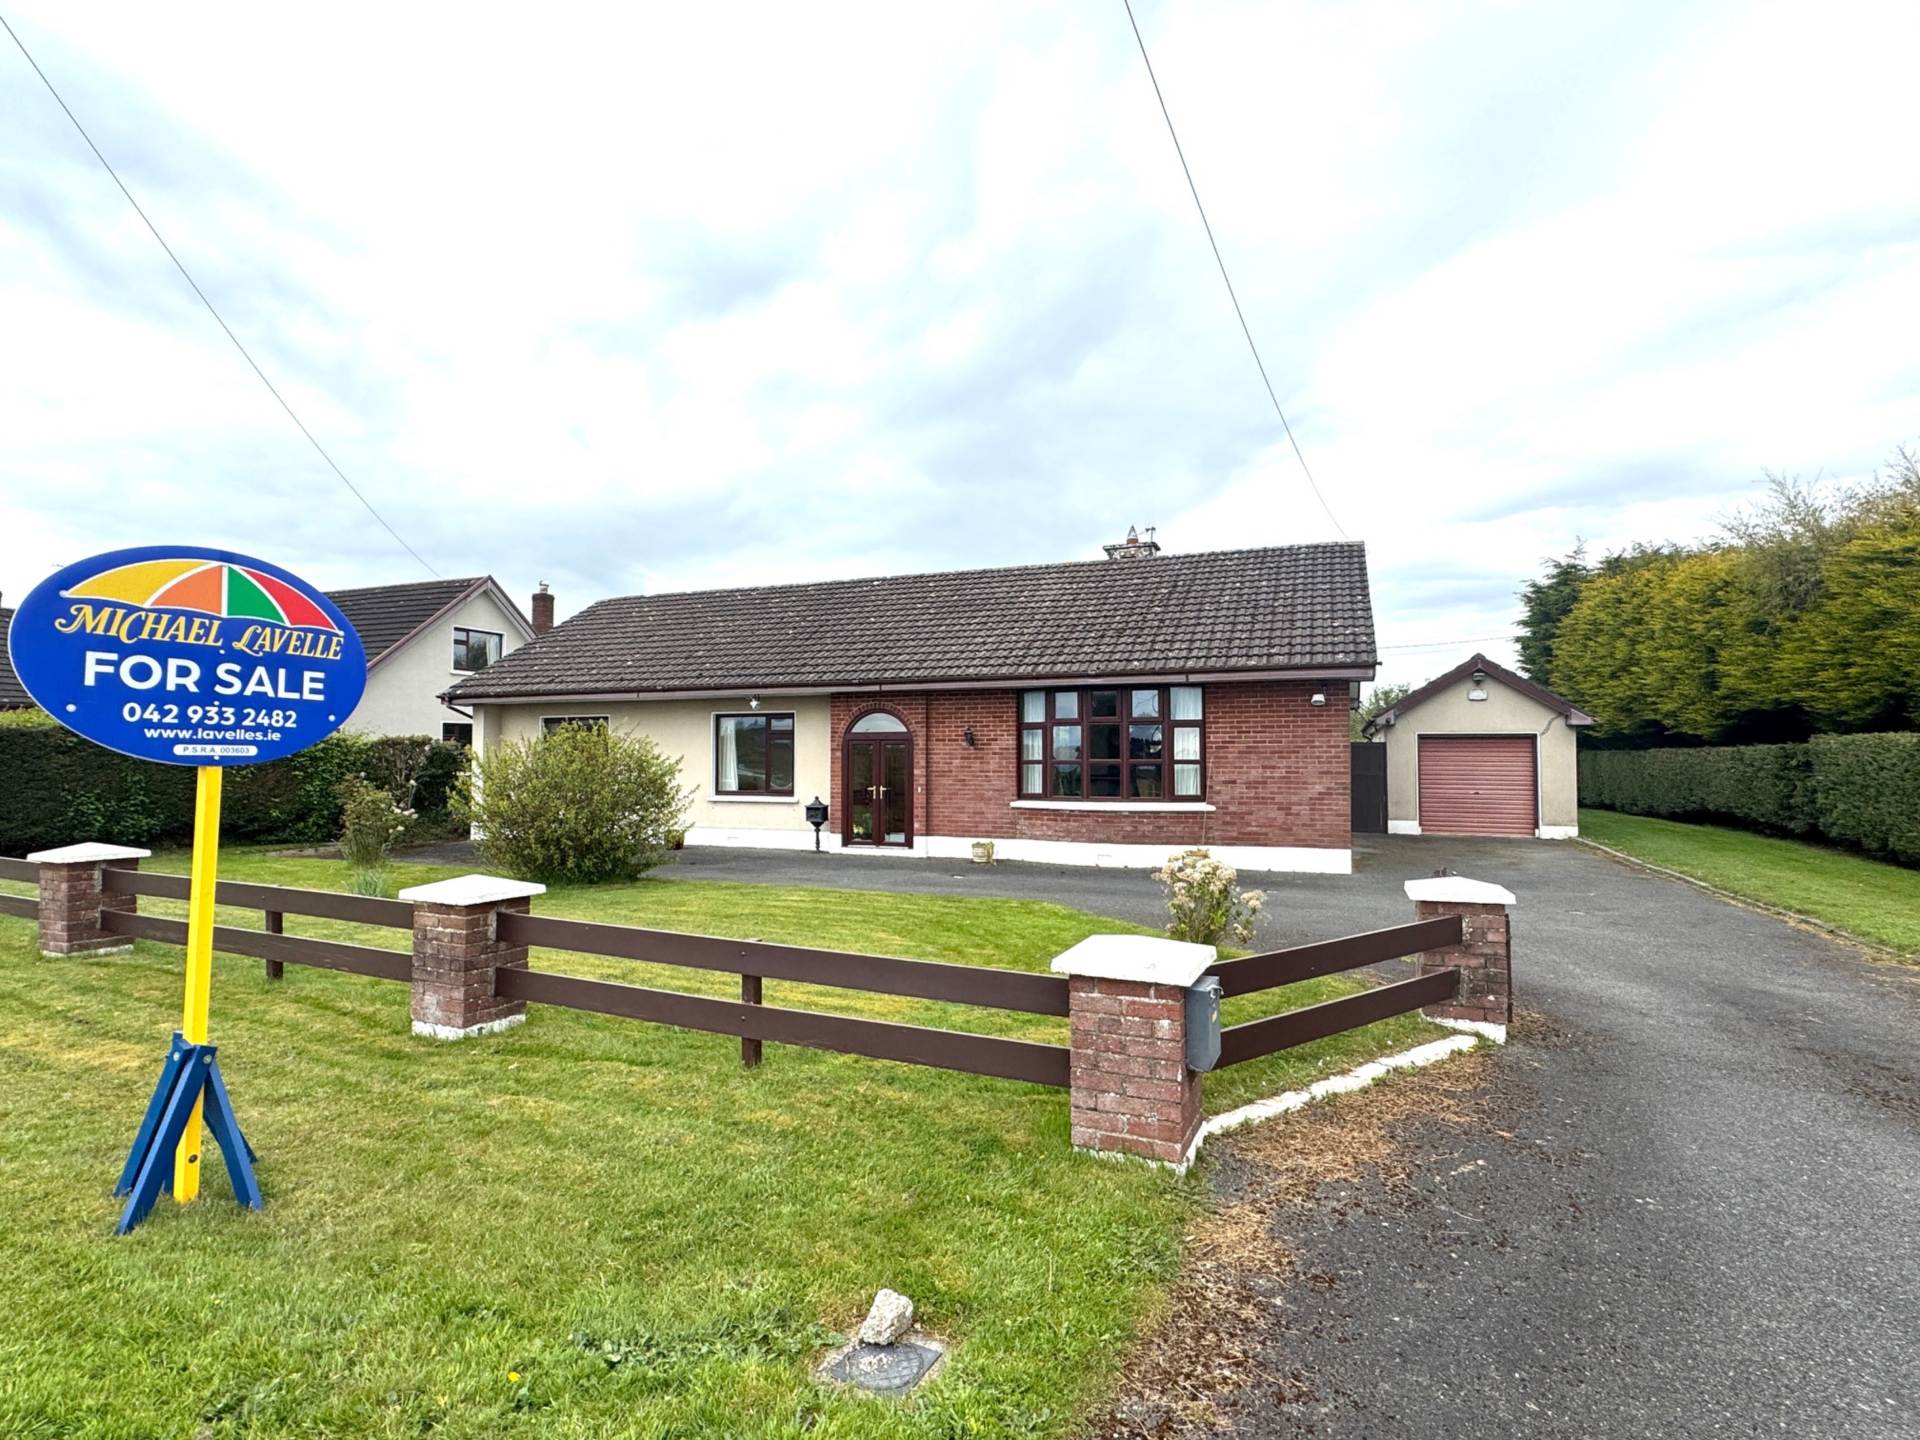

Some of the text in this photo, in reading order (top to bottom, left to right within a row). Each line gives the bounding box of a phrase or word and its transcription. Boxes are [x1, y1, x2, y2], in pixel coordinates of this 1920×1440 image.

[55, 604, 344, 660] MICHAEL LAVELLE
[84, 650, 326, 701] FOR SALE
[122, 702, 297, 728] 042 933 2482
[144, 727, 281, 742] www.lavelles.ie
